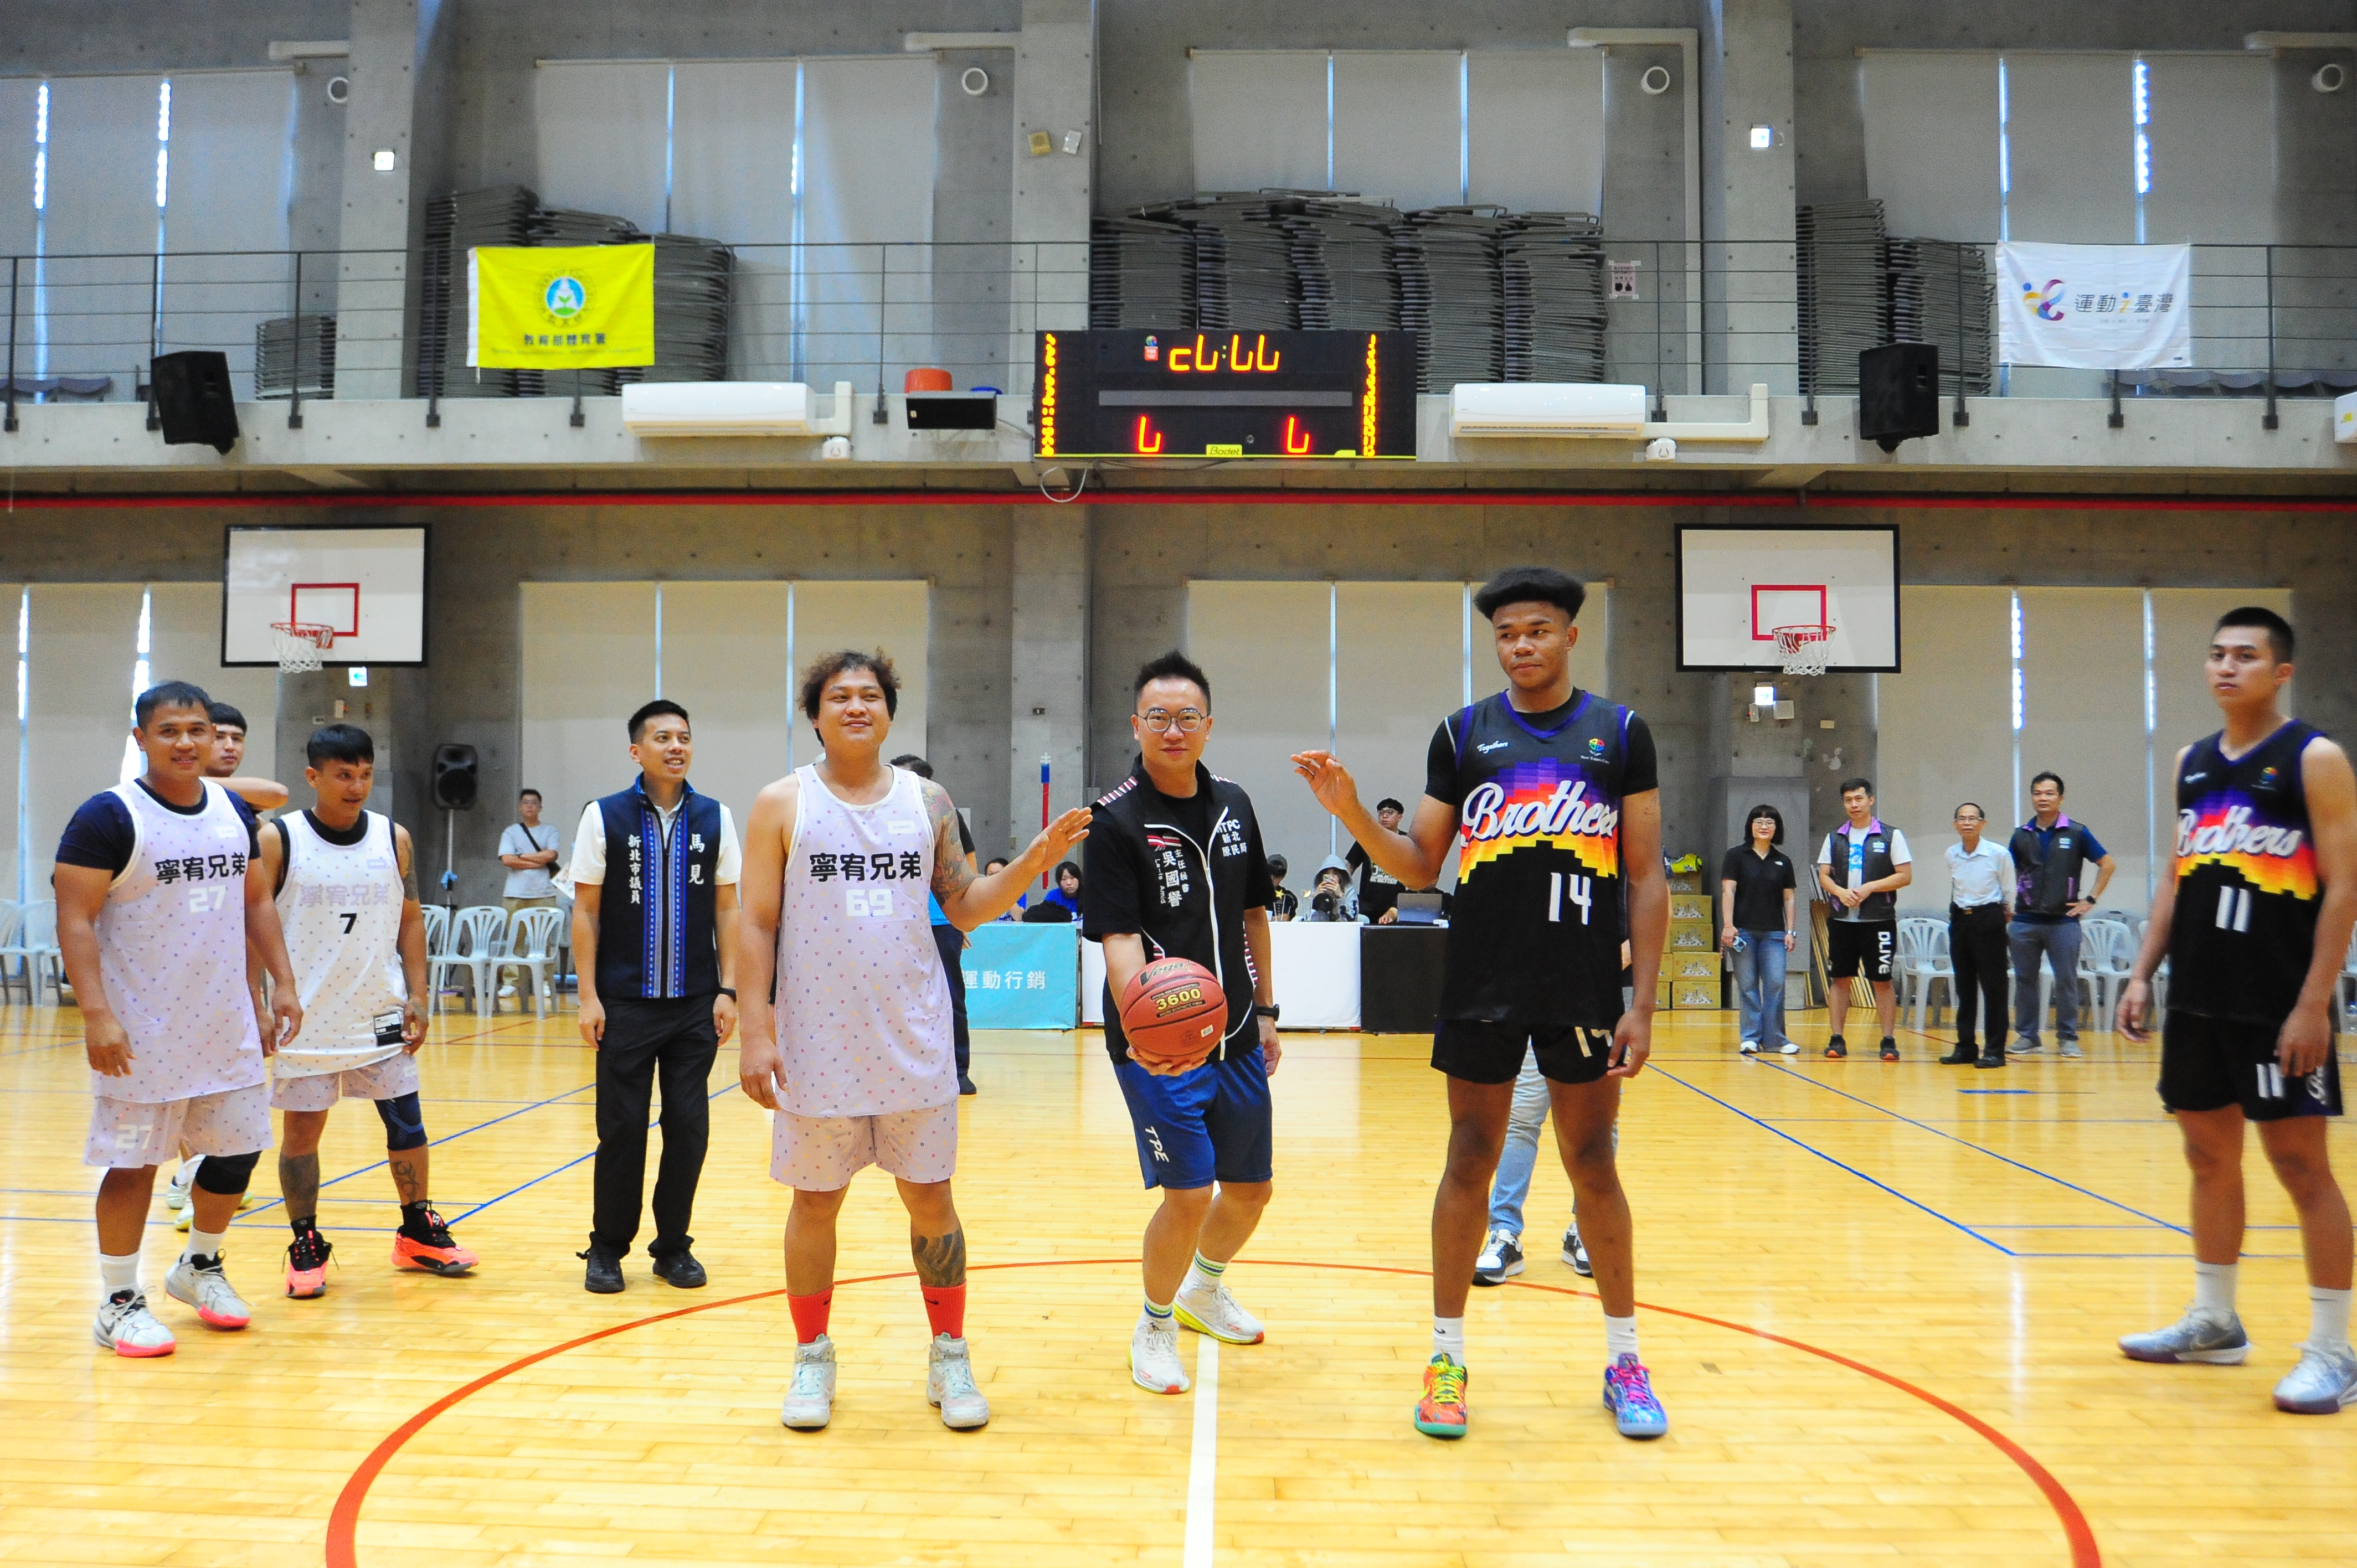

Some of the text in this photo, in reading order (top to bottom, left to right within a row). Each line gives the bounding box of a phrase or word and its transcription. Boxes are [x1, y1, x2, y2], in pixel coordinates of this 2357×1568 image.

[1210, 446, 1240, 455] Bodet
[1222, 831, 1241, 843] 新北
[1222, 842, 1247, 857] 原民局
[155, 852, 246, 884] 寧宥兄弟
[627, 833, 643, 905] 新北市議員
[688, 833, 706, 885] 馬見
[809, 851, 922, 882] 寧宥兄弟
[1174, 849, 1190, 893] 主任秘書
[189, 885, 227, 913] 27
[846, 889, 893, 916] 69
[1549, 873, 1591, 925] 14
[2216, 886, 2252, 932] 11
[339, 913, 357, 934] 7
[1139, 963, 1184, 987] Vega
[1155, 988, 1201, 1011] 3600
[2256, 1062, 2286, 1098] 11
[115, 1124, 153, 1149] 27
[1145, 1126, 1170, 1163] TPE
